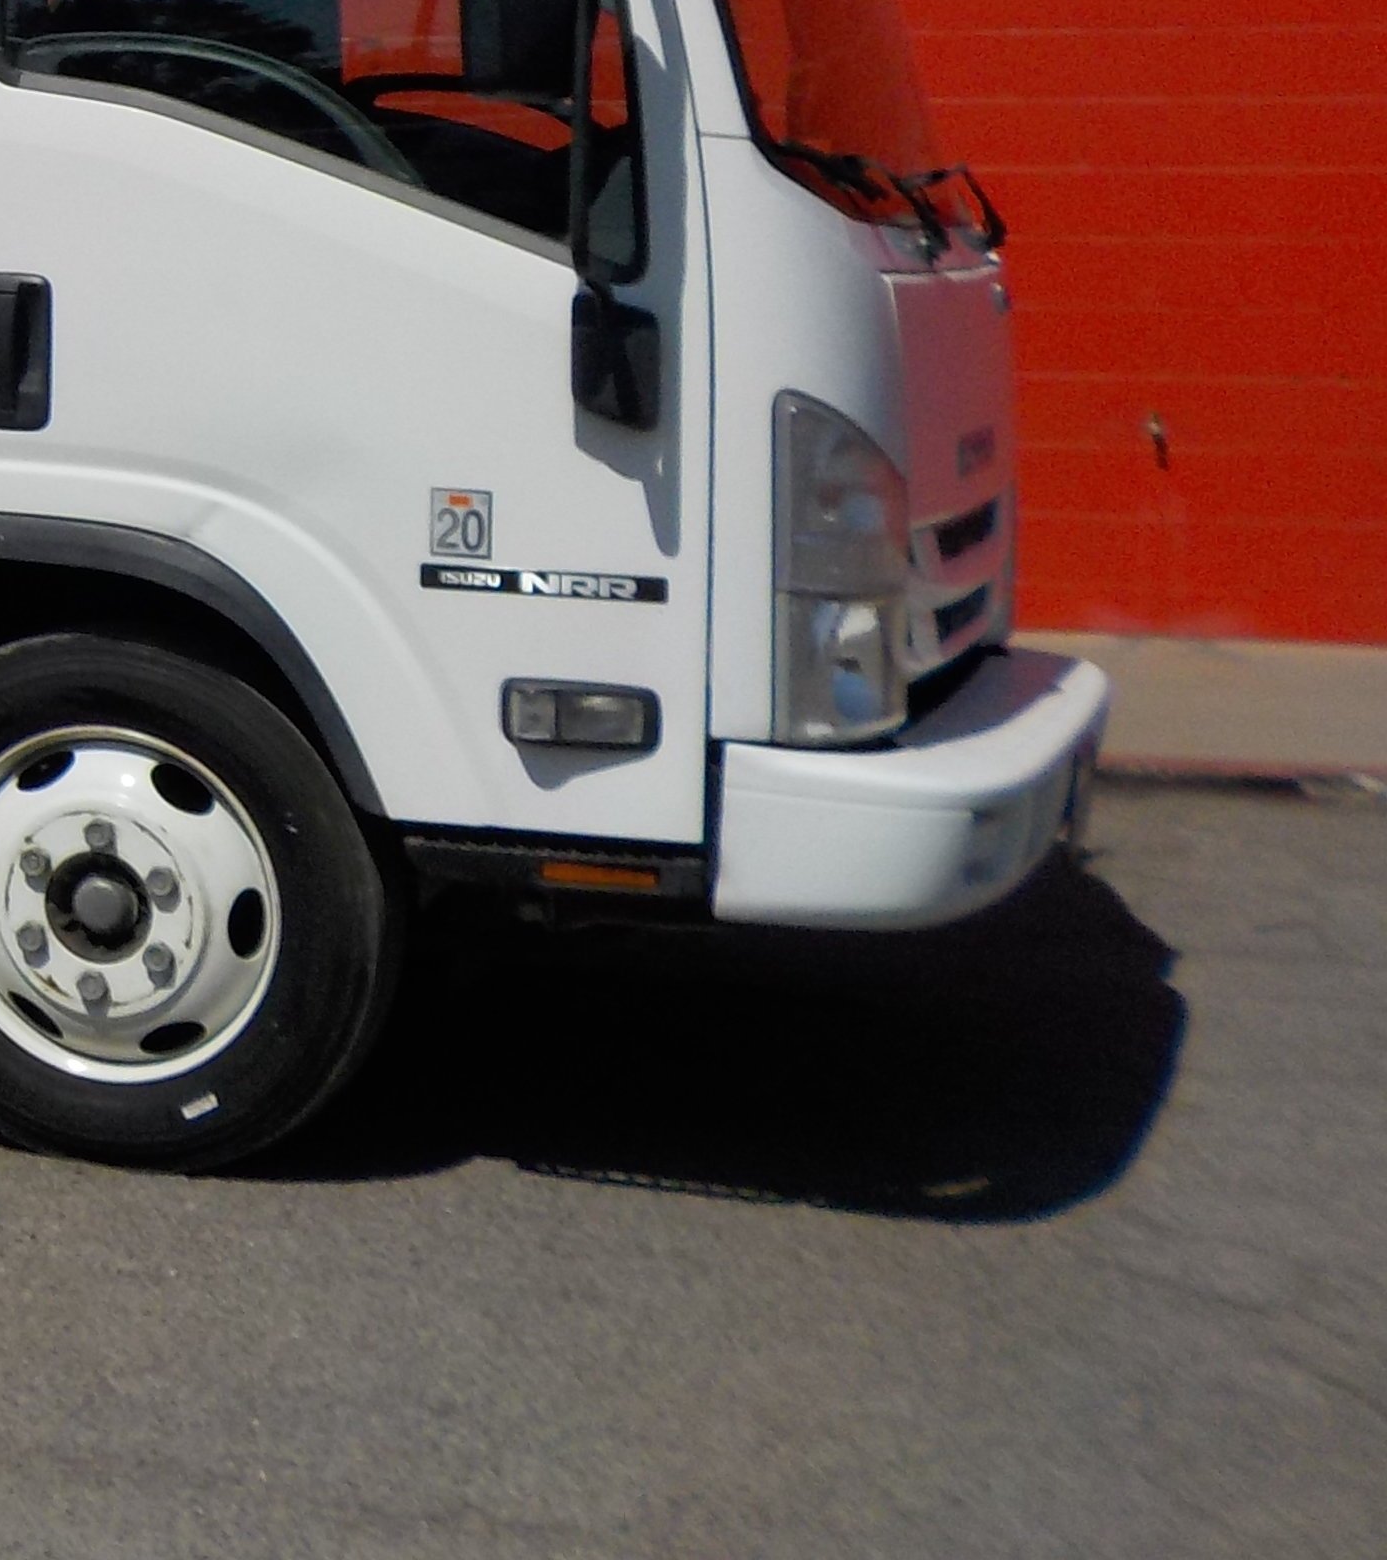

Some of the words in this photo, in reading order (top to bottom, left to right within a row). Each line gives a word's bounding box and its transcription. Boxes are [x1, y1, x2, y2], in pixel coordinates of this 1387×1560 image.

[436, 507, 486, 552] 20
[438, 571, 502, 588] ISUZU
[520, 571, 638, 601] NRR
